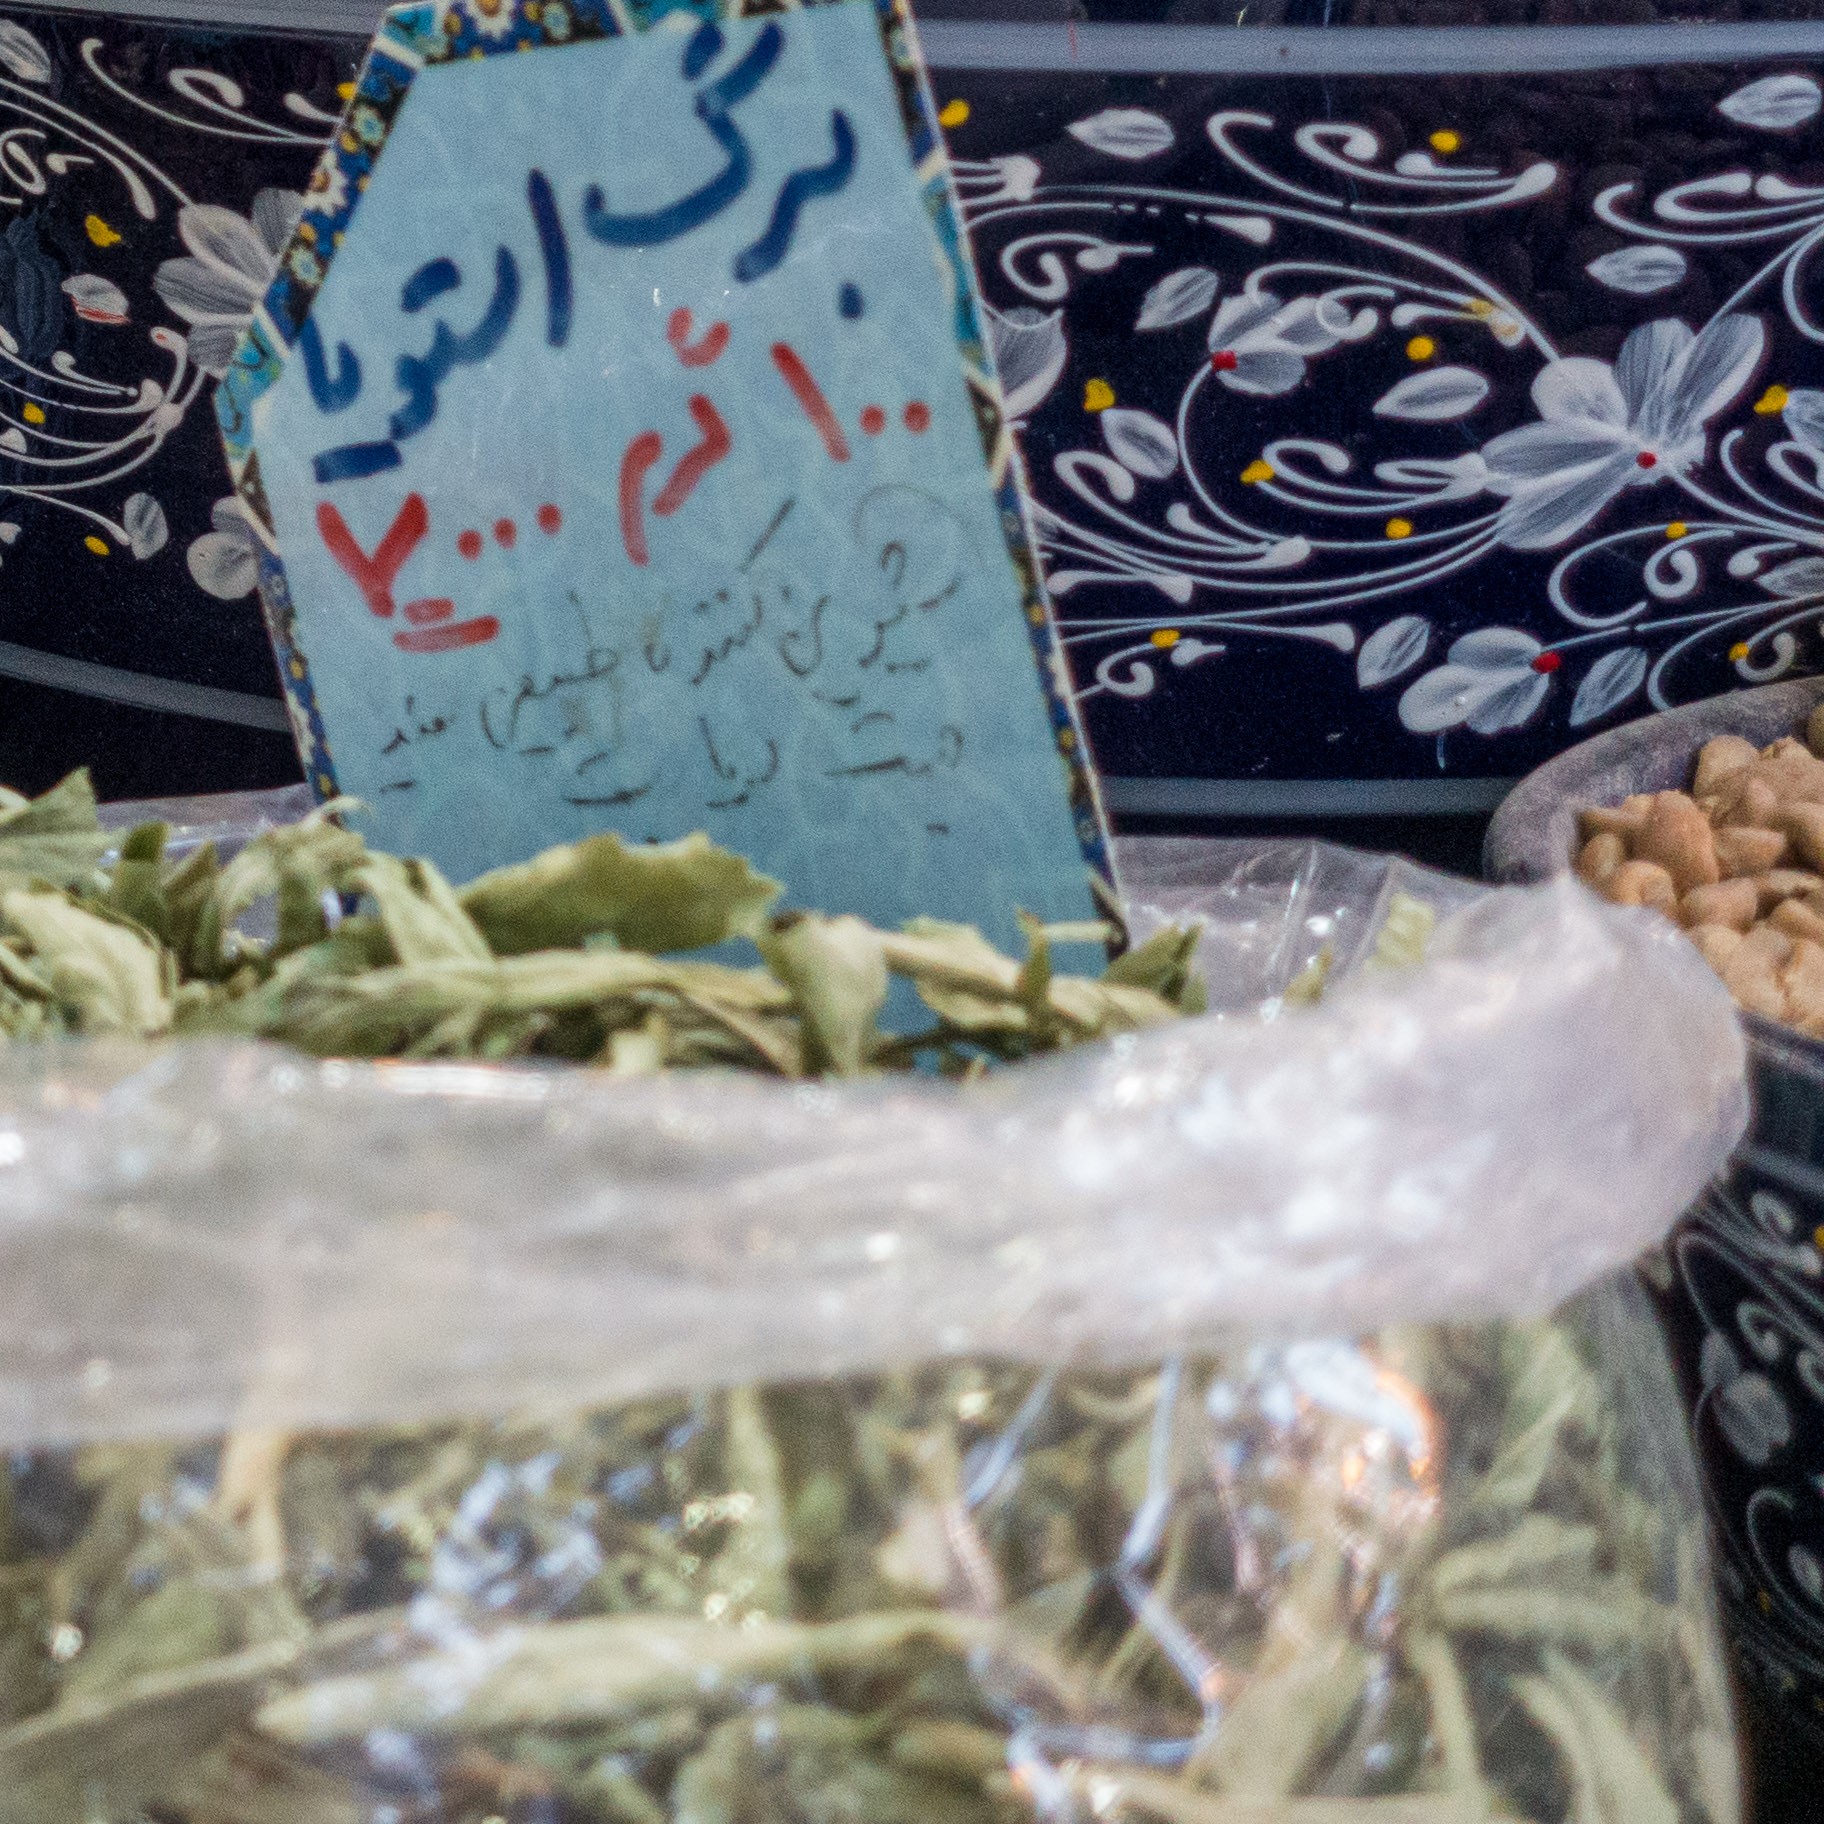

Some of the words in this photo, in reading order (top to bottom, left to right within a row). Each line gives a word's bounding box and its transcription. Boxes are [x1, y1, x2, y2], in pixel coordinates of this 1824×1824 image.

[583, 21, 859, 323] برگ
[617, 305, 734, 567] گرم
[769, 340, 931, 463] ۱۰۰
[315, 492, 563, 619] ۷۰۰۰
